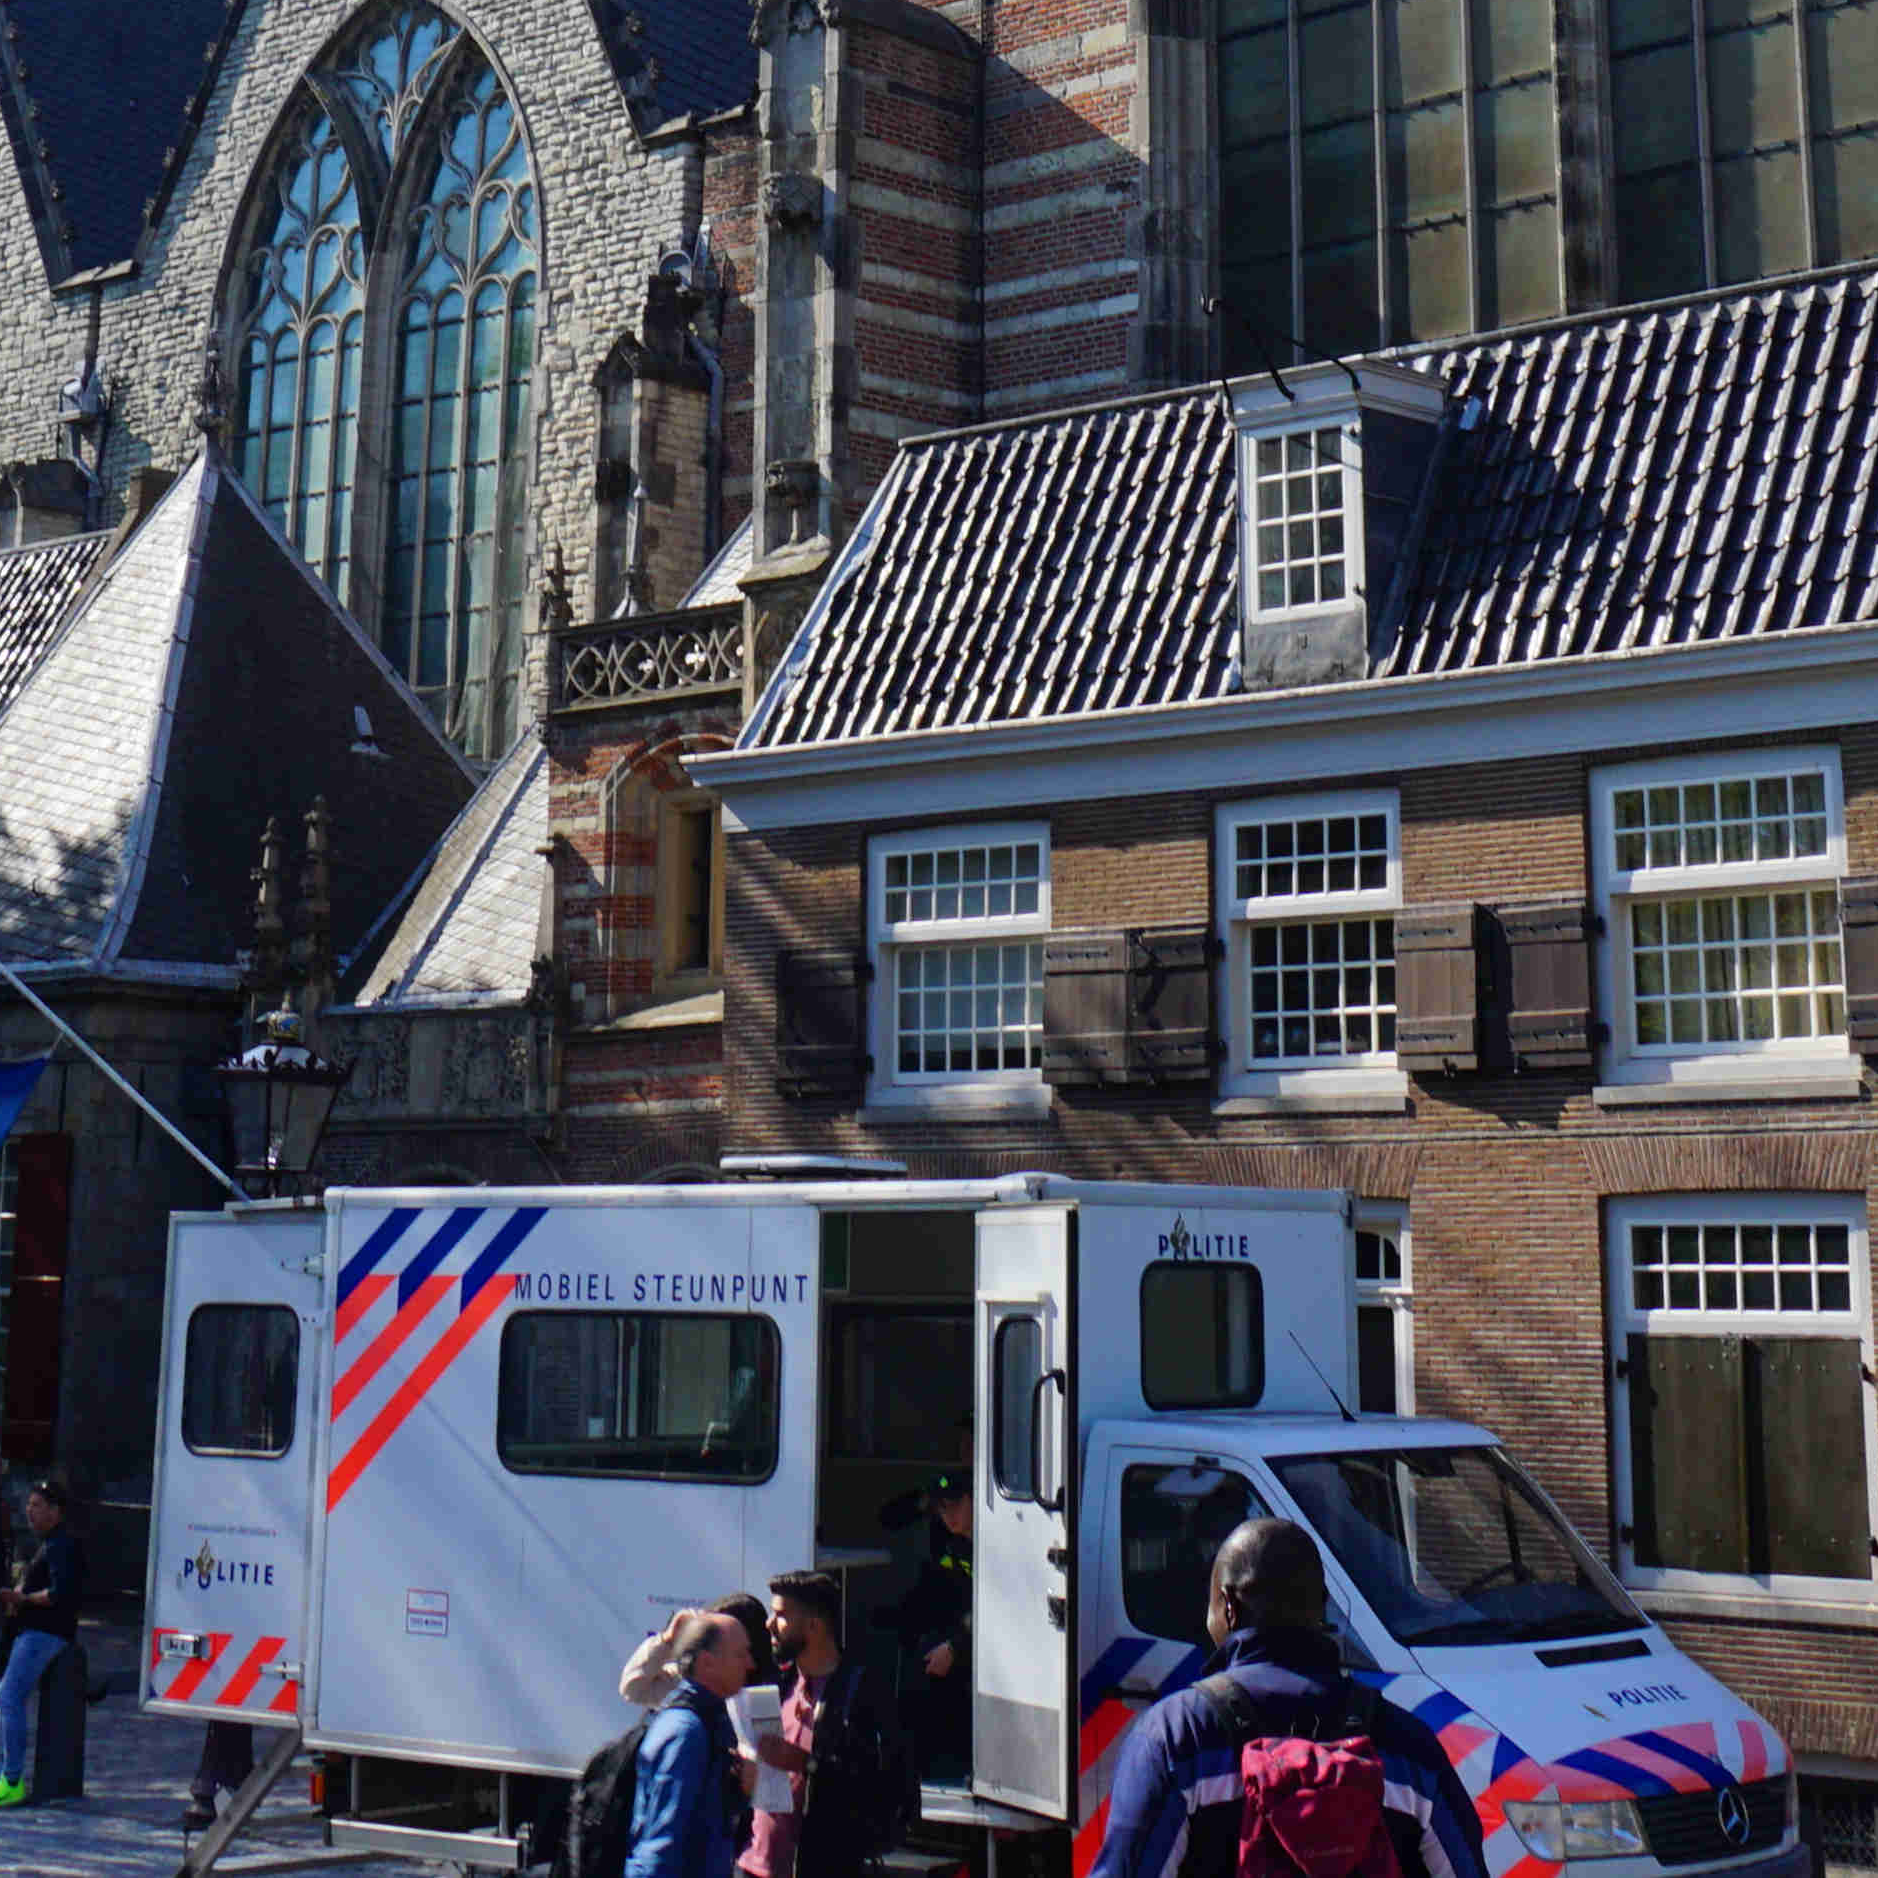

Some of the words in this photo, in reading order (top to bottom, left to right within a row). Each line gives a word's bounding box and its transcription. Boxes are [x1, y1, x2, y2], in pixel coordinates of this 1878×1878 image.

[514, 1272, 615, 1301] MOBIEL
[633, 1273, 809, 1303] STEUNPUNT
[183, 1557, 275, 1590] POLITIE
[1608, 1684, 1690, 1709] POLITIE
